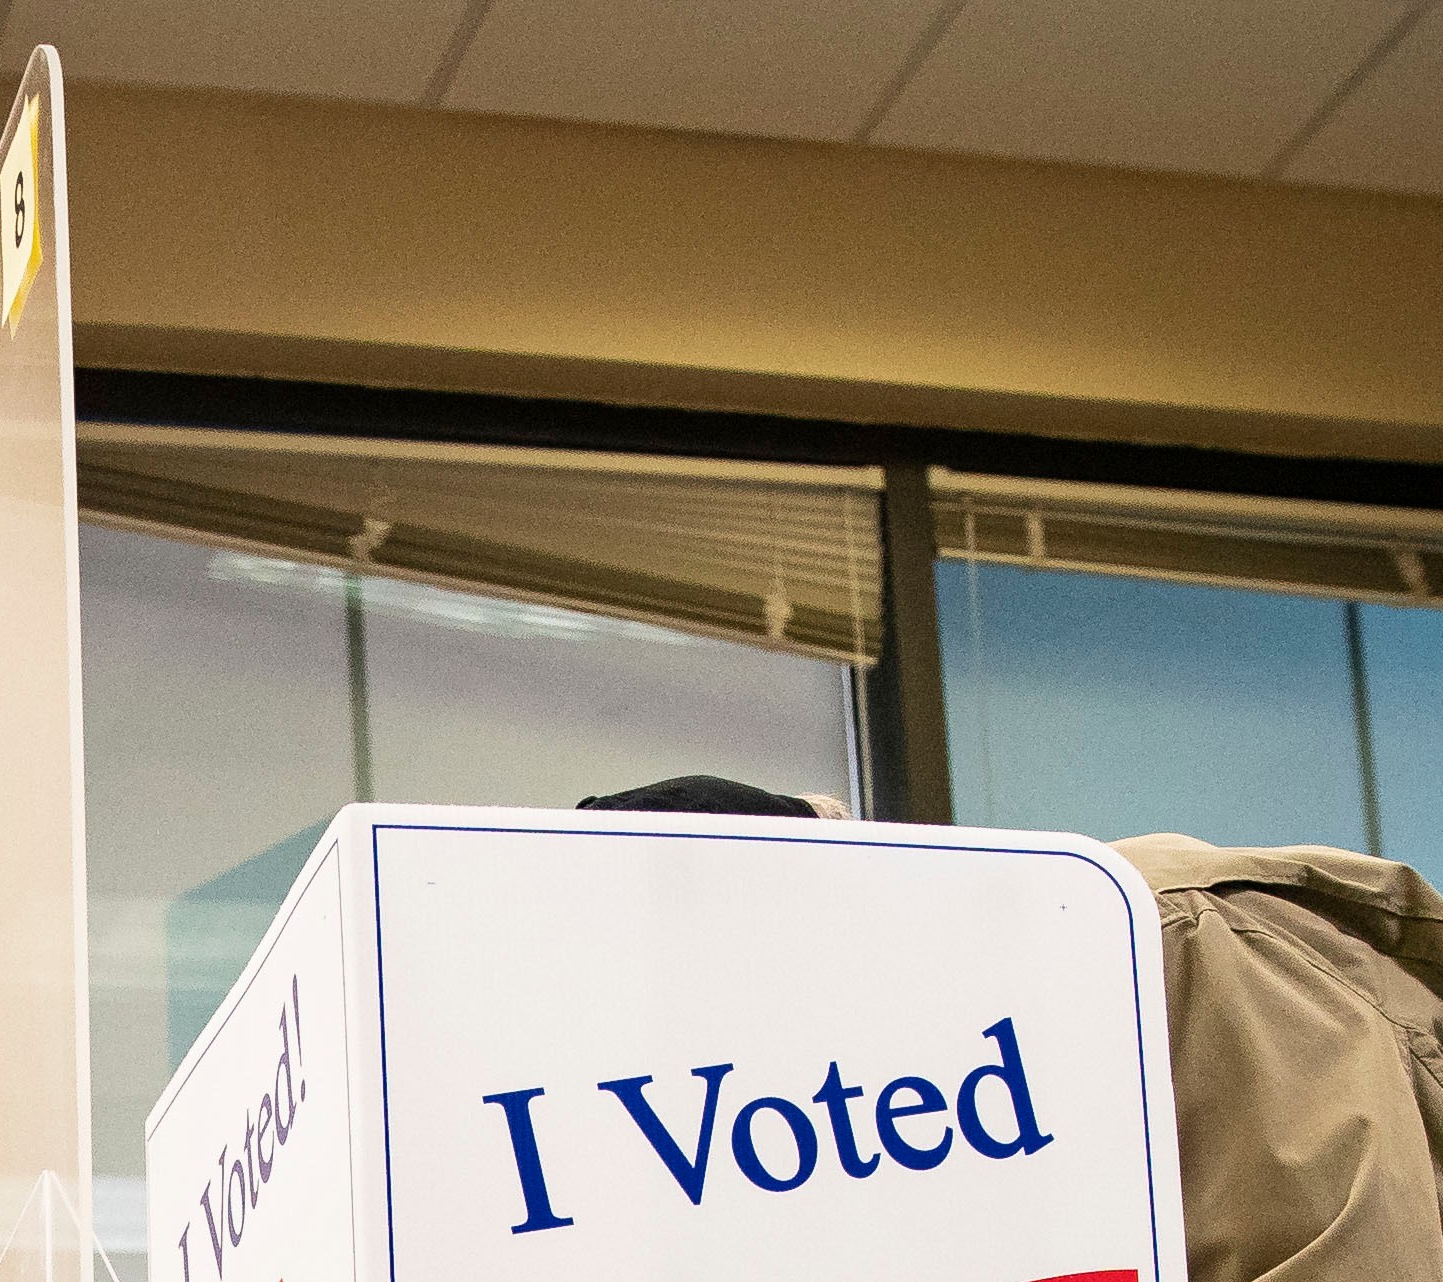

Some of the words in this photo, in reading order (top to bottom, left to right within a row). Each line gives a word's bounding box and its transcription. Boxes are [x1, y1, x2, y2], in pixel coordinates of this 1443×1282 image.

[199, 973, 307, 1281] Voted!
[482, 1086, 575, 1235] I
[596, 1016, 1055, 1206] Voted
